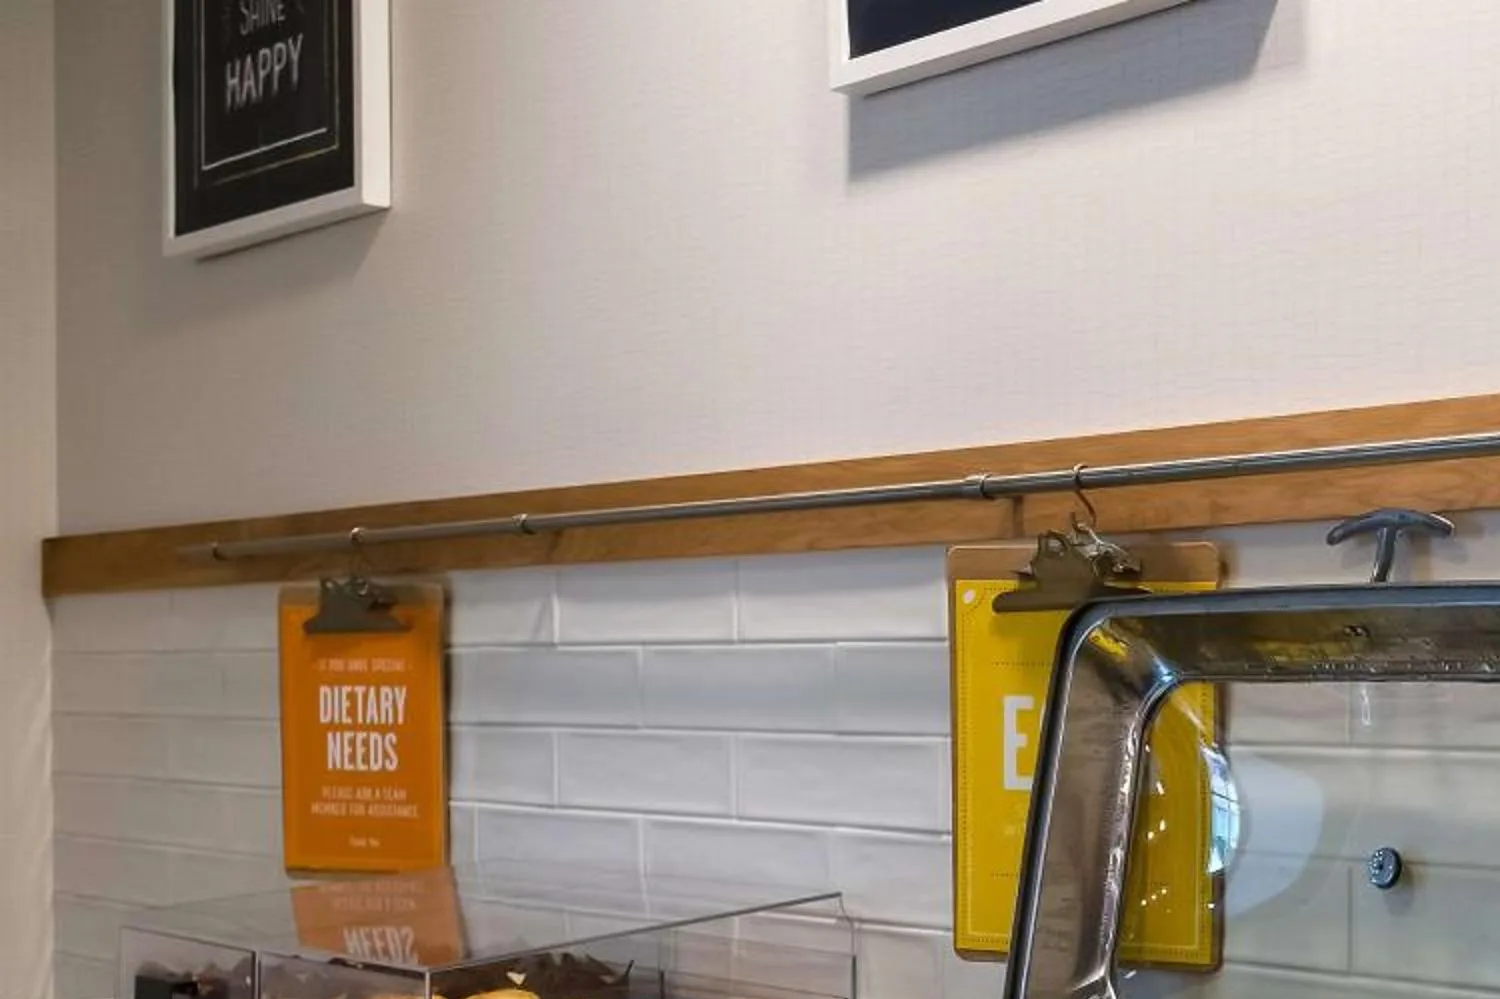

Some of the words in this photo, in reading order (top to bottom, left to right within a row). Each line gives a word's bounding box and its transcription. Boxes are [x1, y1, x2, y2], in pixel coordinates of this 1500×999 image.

[226, 33, 303, 110] HAPPY
[319, 685, 407, 726] DIETARY
[327, 731, 399, 772] NEEDS
